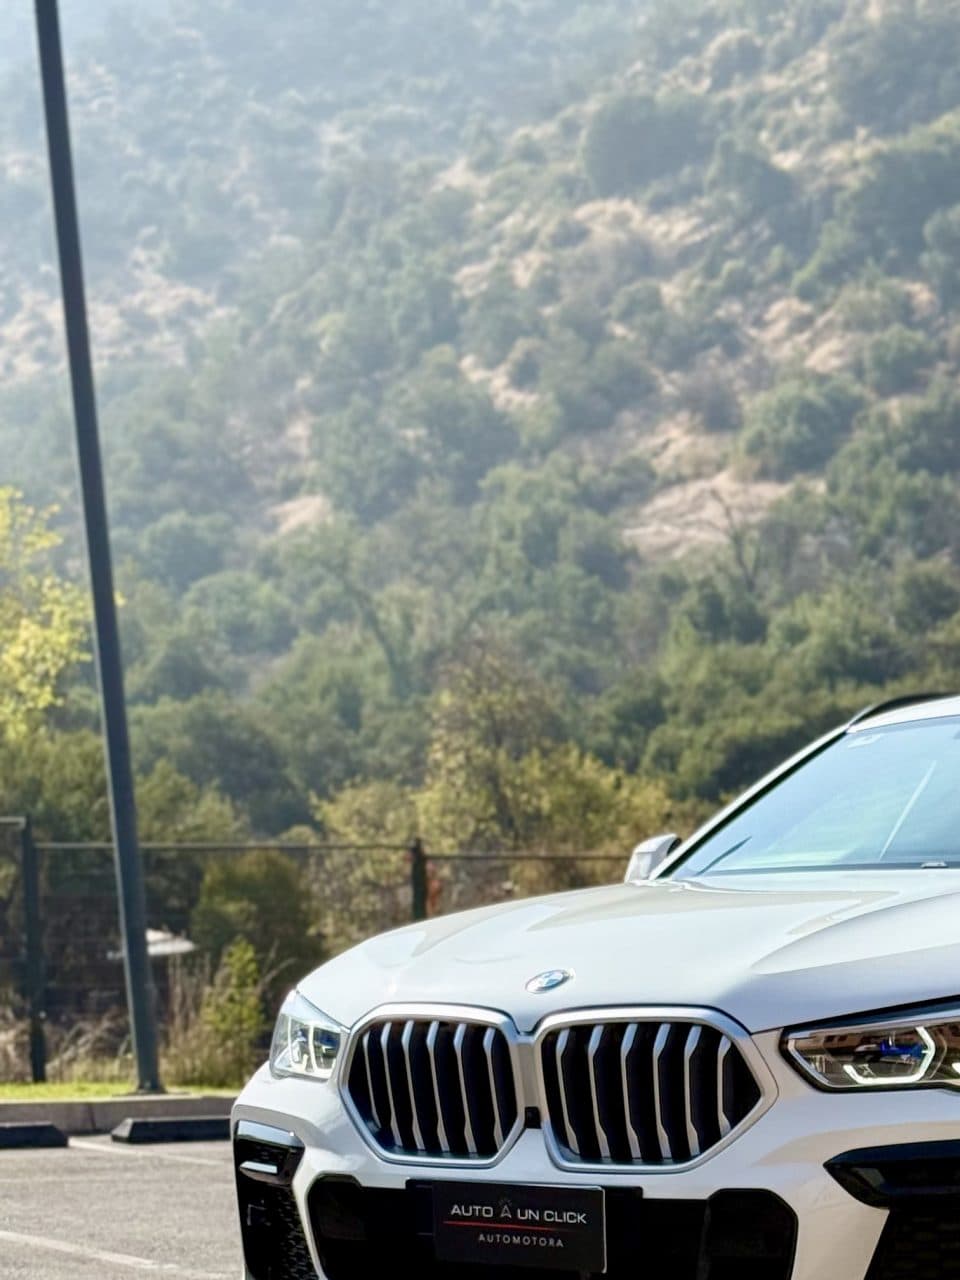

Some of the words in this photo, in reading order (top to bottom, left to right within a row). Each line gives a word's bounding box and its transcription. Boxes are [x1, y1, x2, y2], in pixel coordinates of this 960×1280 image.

[450, 1204, 494, 1218] AUTO
[517, 1207, 540, 1221] UN
[543, 1210, 587, 1224] CLICK
[478, 1233, 564, 1248] AUTOMOTORA
